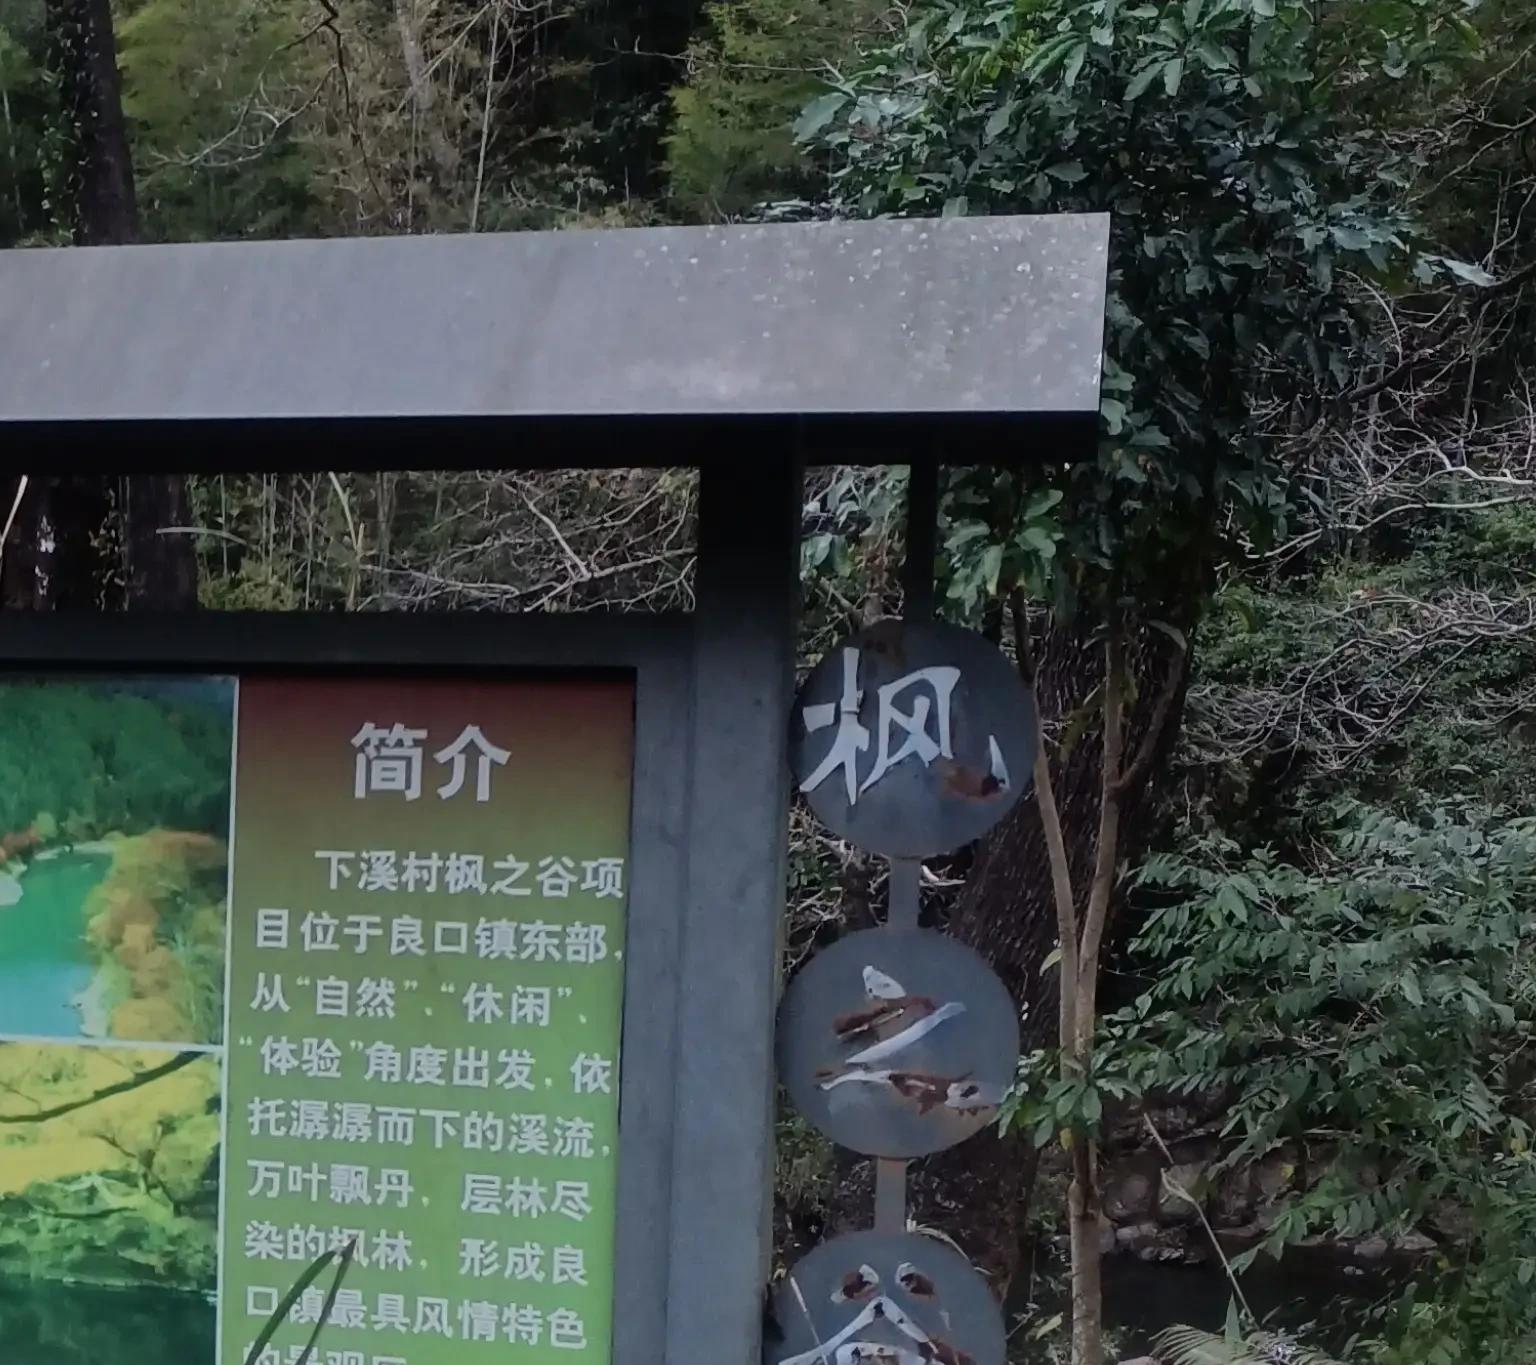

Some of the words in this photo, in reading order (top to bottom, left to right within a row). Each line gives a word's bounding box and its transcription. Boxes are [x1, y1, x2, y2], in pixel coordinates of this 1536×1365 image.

[351, 722, 512, 801] 简介
[314, 850, 624, 899] 下溪村枫之谷项
[255, 908, 624, 964] 目位于良口镇东部，
